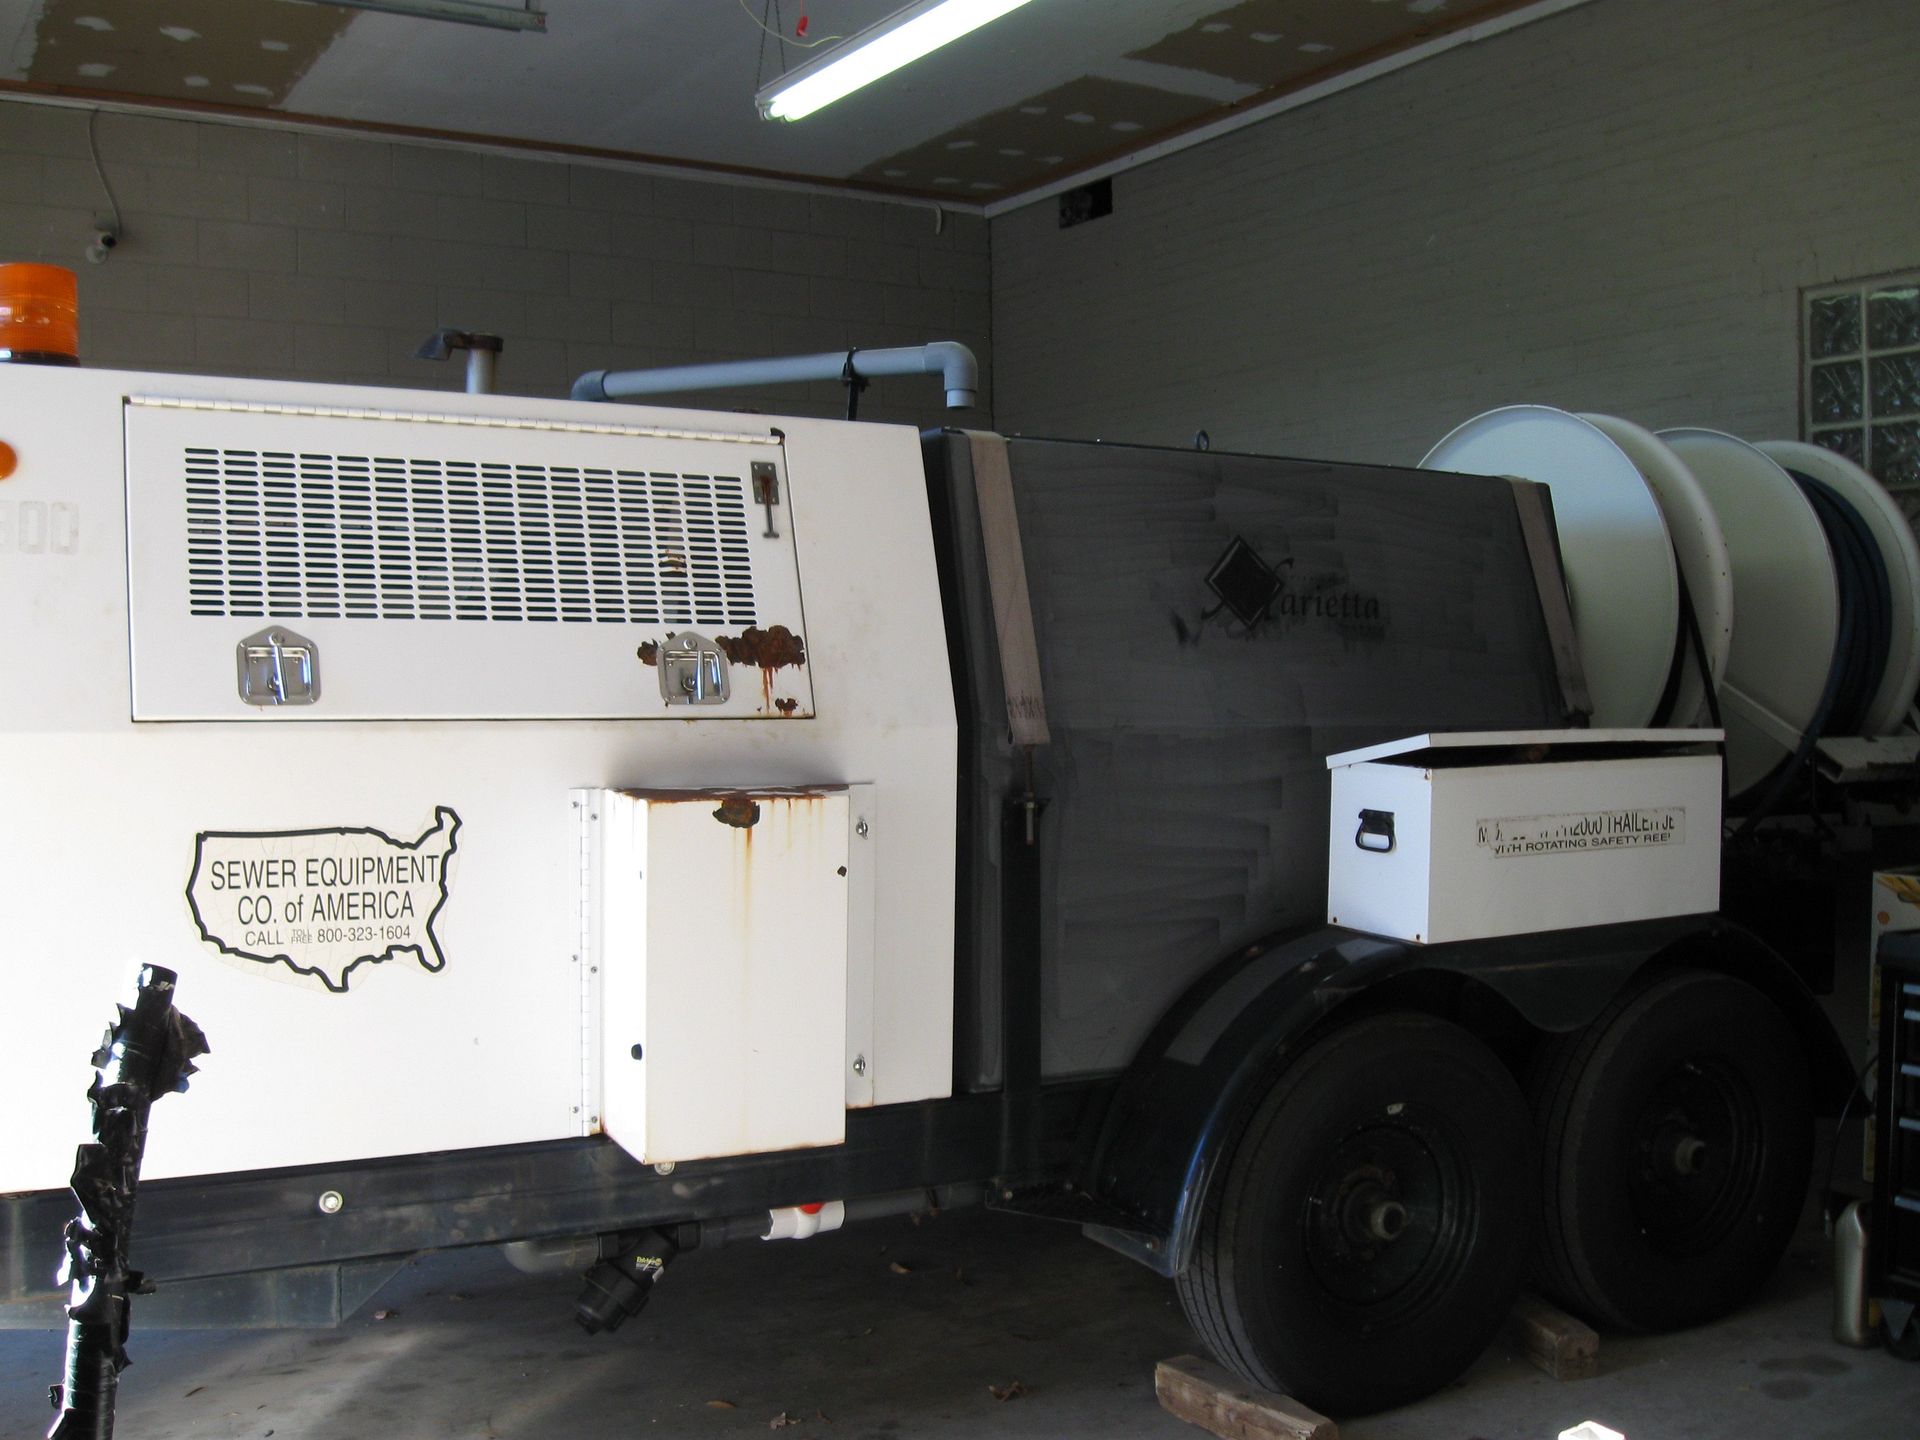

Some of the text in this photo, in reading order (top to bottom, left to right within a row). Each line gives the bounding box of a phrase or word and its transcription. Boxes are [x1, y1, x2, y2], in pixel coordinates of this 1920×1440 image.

[1526, 838, 1587, 852] ROTATING
[1591, 834, 1640, 846] SAFETY
[211, 855, 440, 890] SEWER EQUIPMENT
[238, 890, 415, 925] CO. of AMERICA
[245, 925, 412, 946] CALL 800-323-1604
[291, 936, 313, 944] FREE
[292, 929, 313, 937] TOLL
